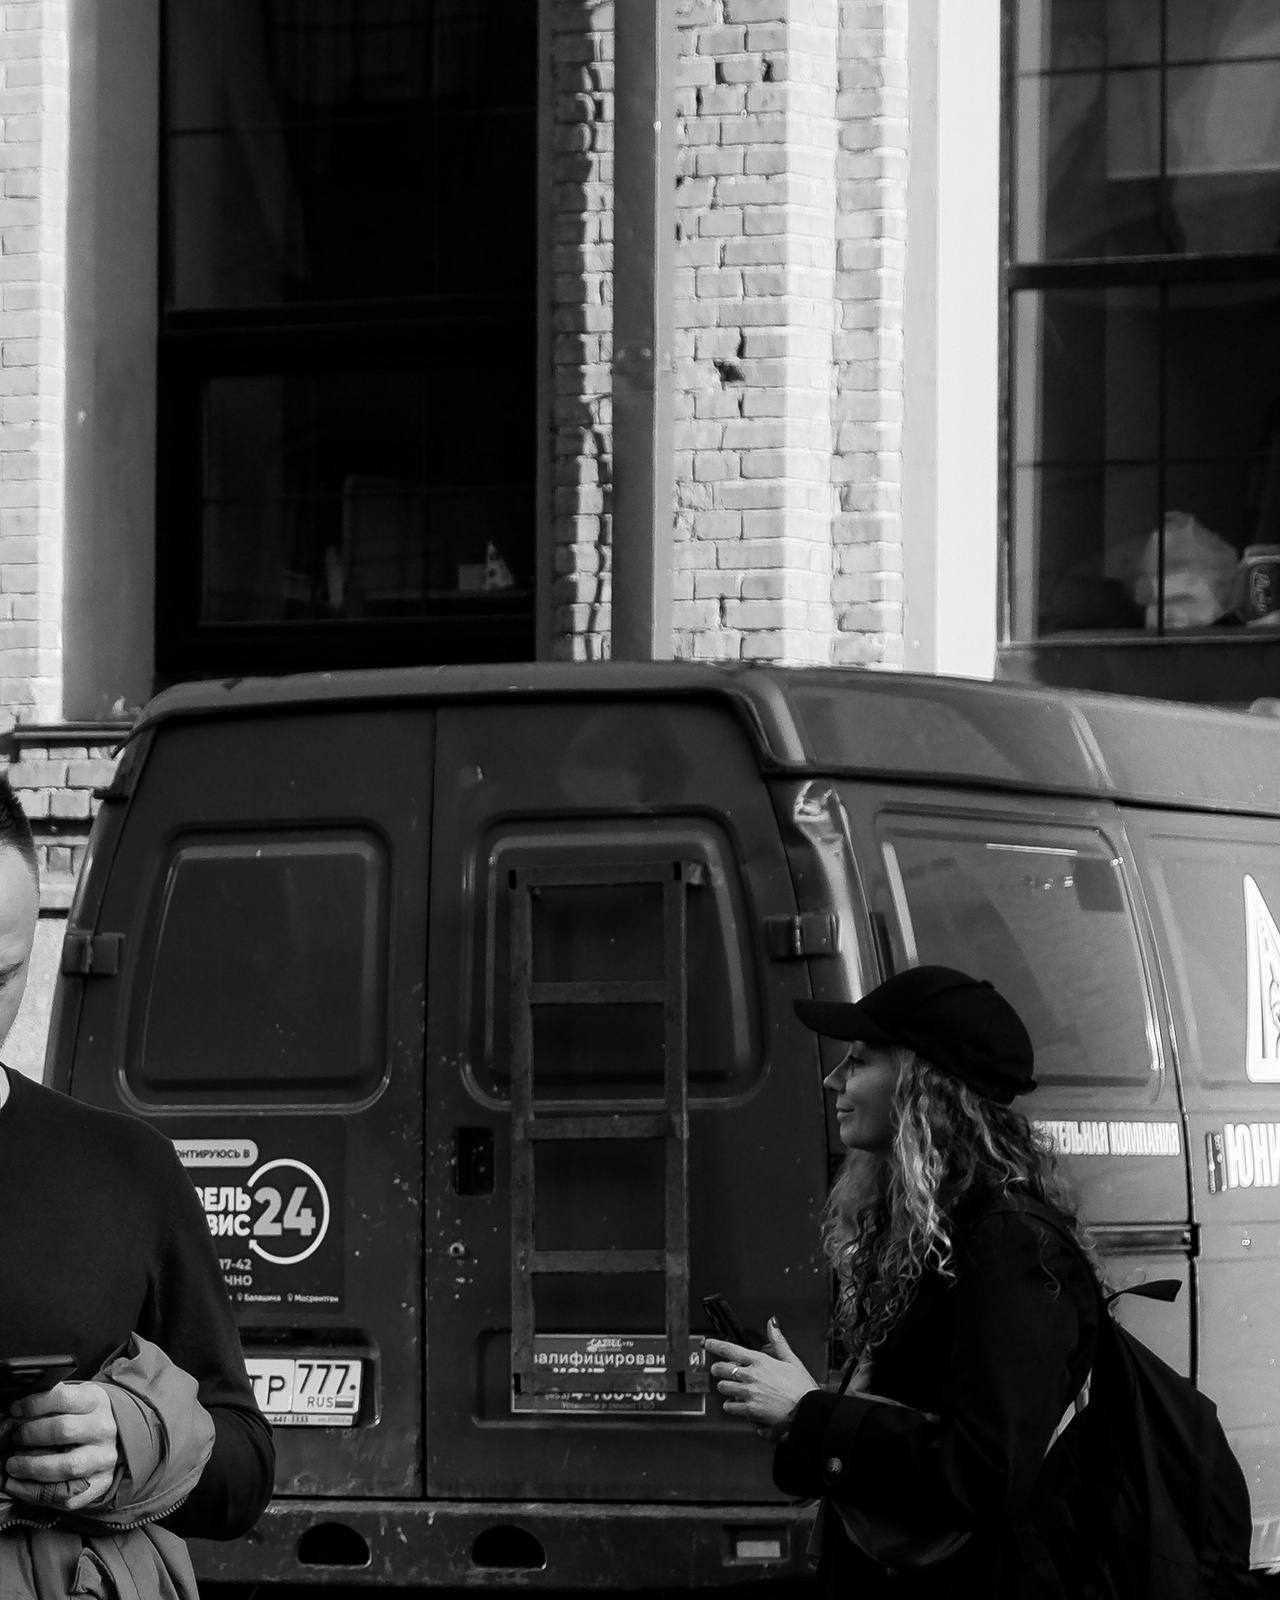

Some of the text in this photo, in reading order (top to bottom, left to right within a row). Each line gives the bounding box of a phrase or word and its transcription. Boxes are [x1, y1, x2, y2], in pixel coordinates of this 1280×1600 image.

[1108, 1122, 1180, 1155] КОМПАНИЯ
[244, 1149, 251, 1159] В
[253, 1186, 317, 1236] 24
[224, 1274, 253, 1287] ЧНО
[298, 1364, 350, 1395] 777
[307, 1396, 334, 1408] RUS
